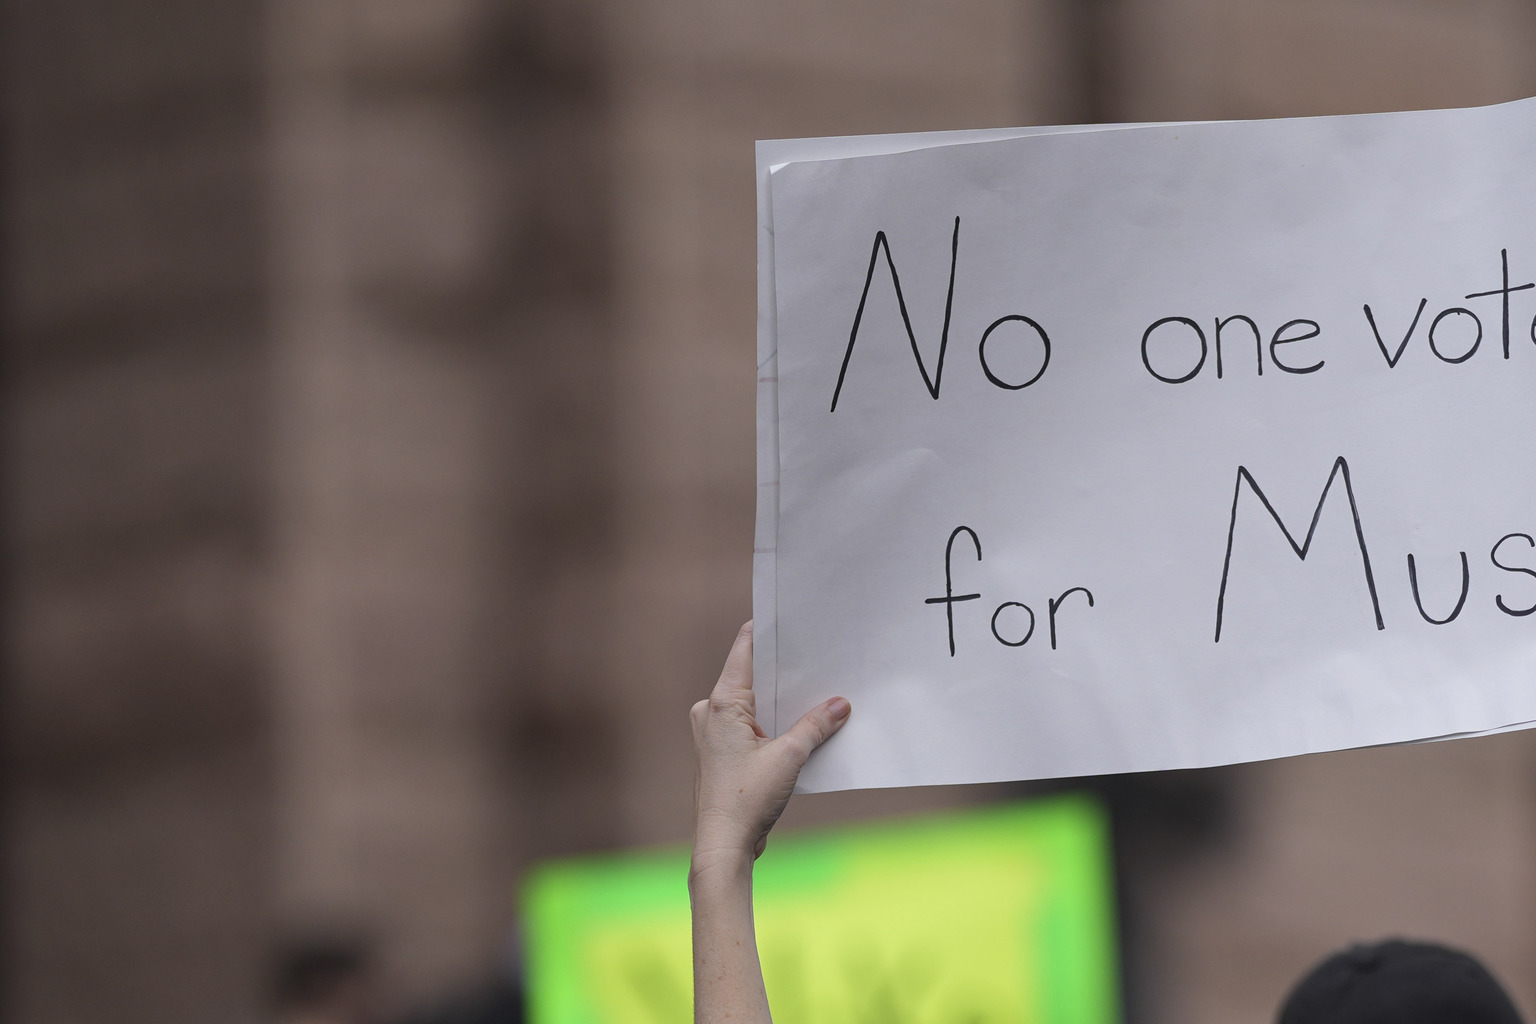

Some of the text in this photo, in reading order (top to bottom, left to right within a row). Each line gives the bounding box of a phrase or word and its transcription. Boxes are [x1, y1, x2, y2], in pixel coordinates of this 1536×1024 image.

[830, 215, 1051, 413] No
[1140, 314, 1325, 385] one
[924, 525, 1094, 658] for
